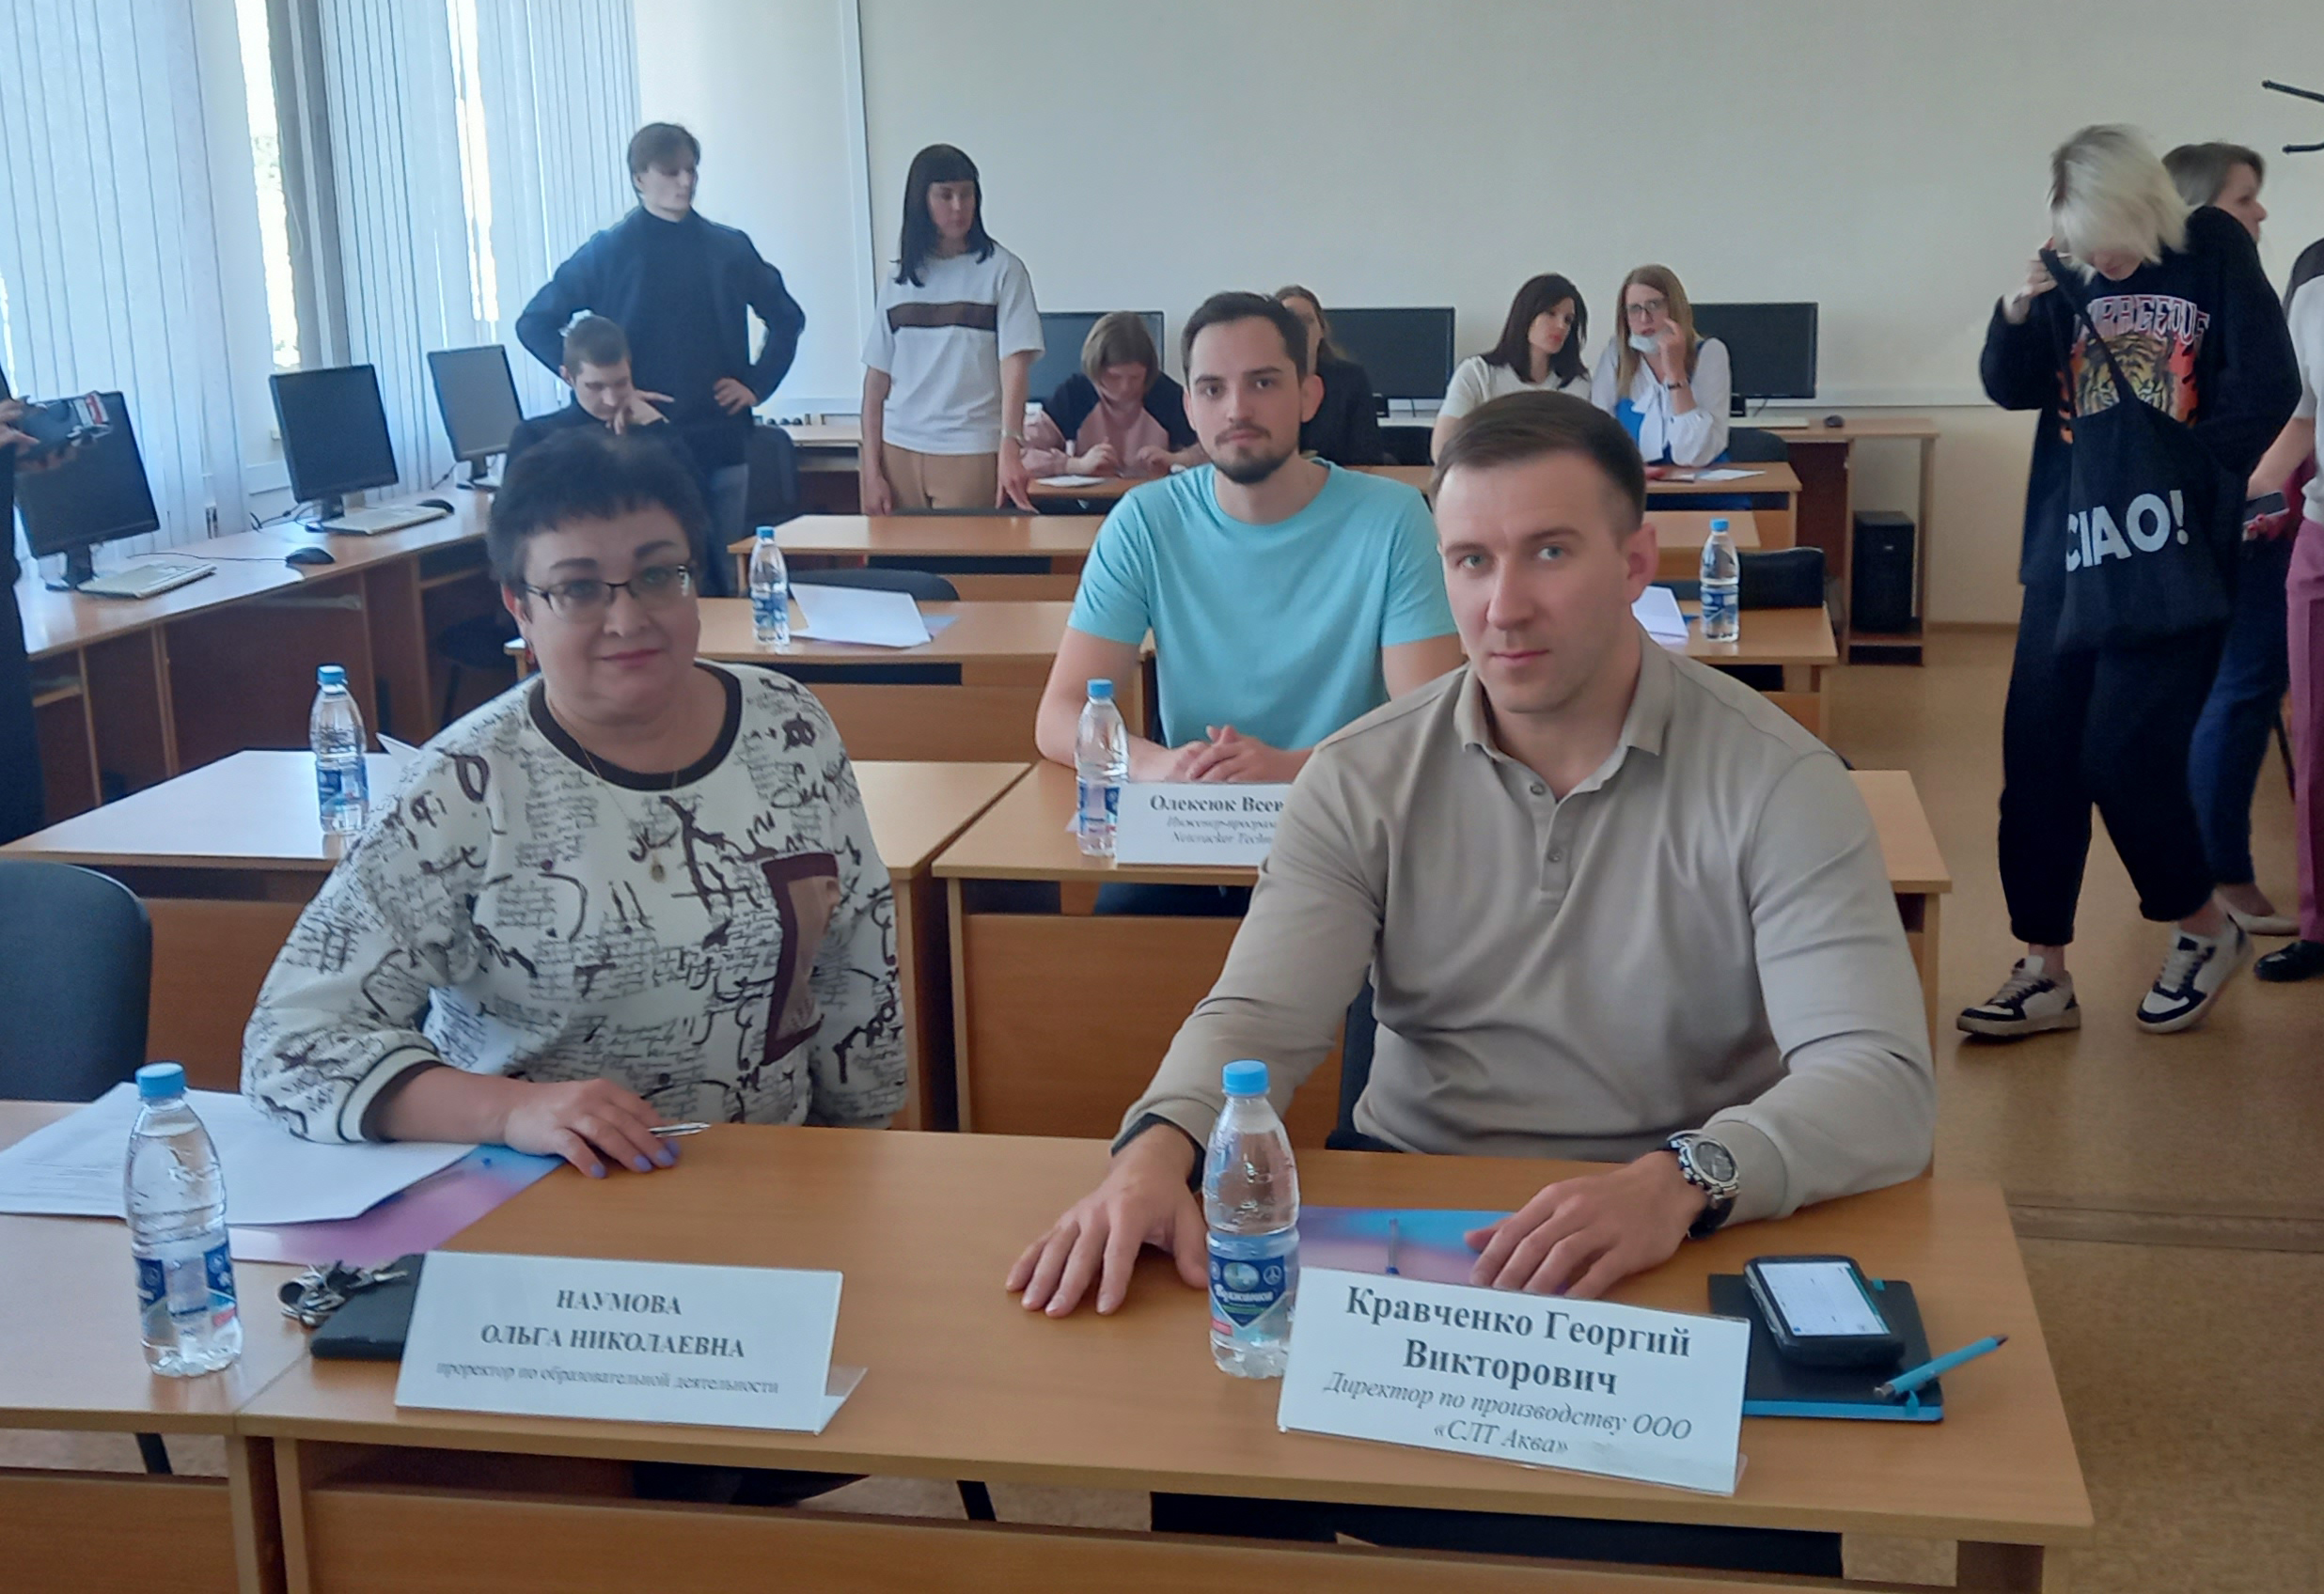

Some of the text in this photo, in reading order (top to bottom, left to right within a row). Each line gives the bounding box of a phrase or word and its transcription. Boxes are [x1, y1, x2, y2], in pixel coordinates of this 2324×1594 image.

[2065, 490, 2189, 571] CIAO!
[1150, 794, 1237, 813] Олексюк
[556, 1289, 682, 1316] НАУМОВА
[1345, 1285, 1691, 1357] Кравченко Георгий
[480, 1323, 745, 1358] ОЛЬГА НИКОЛАЕВНА
[436, 1362, 778, 1394] проректор по образовательной деятельности
[1402, 1336, 1618, 1397] Викторович
[1322, 1371, 1692, 1440] Директор по производству ООО
[1433, 1419, 1569, 1455] «СЛТ Аква»
